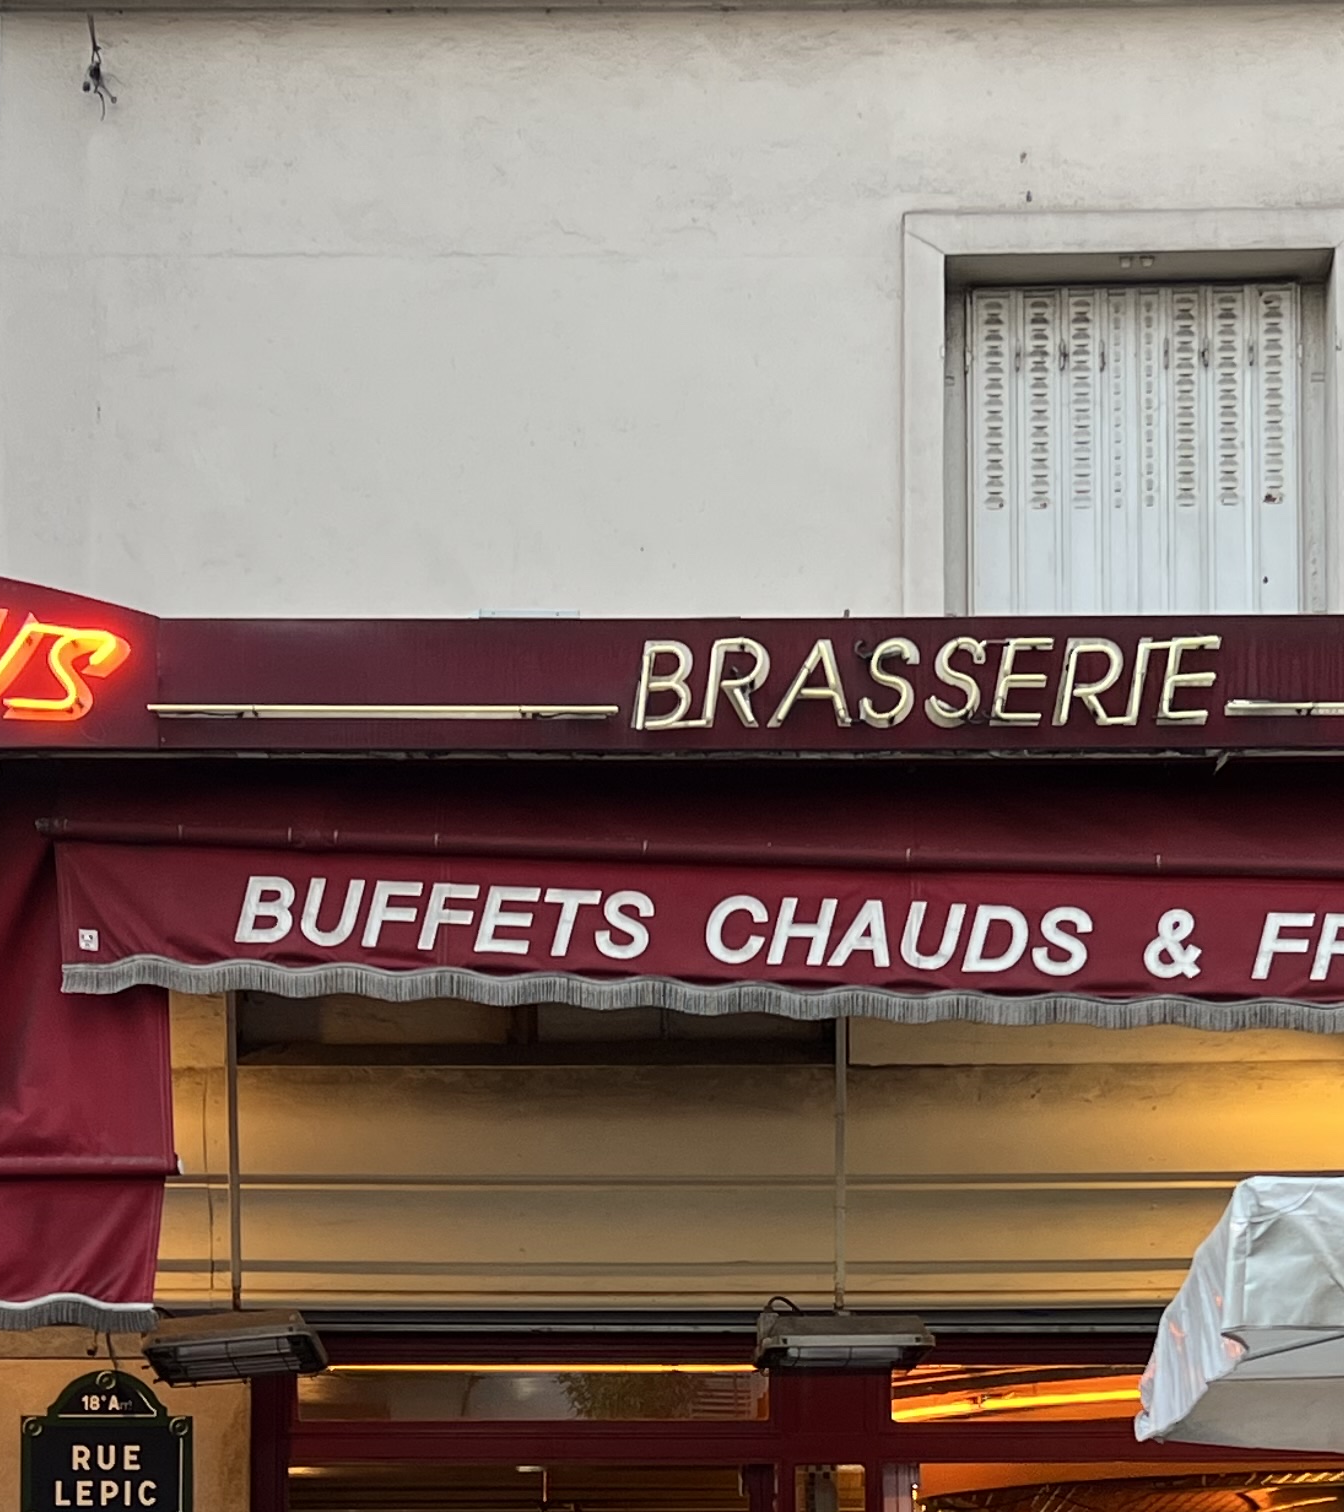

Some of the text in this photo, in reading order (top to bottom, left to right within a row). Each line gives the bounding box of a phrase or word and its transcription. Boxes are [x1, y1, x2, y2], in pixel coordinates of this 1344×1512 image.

[631, 634, 1222, 730] BRASSERIE
[234, 875, 655, 961] BUFFETS
[704, 894, 1094, 977] CHAUDS
[1143, 907, 1203, 978] &
[72, 1444, 141, 1471] RUE
[55, 1480, 157, 1507] LEPIC
